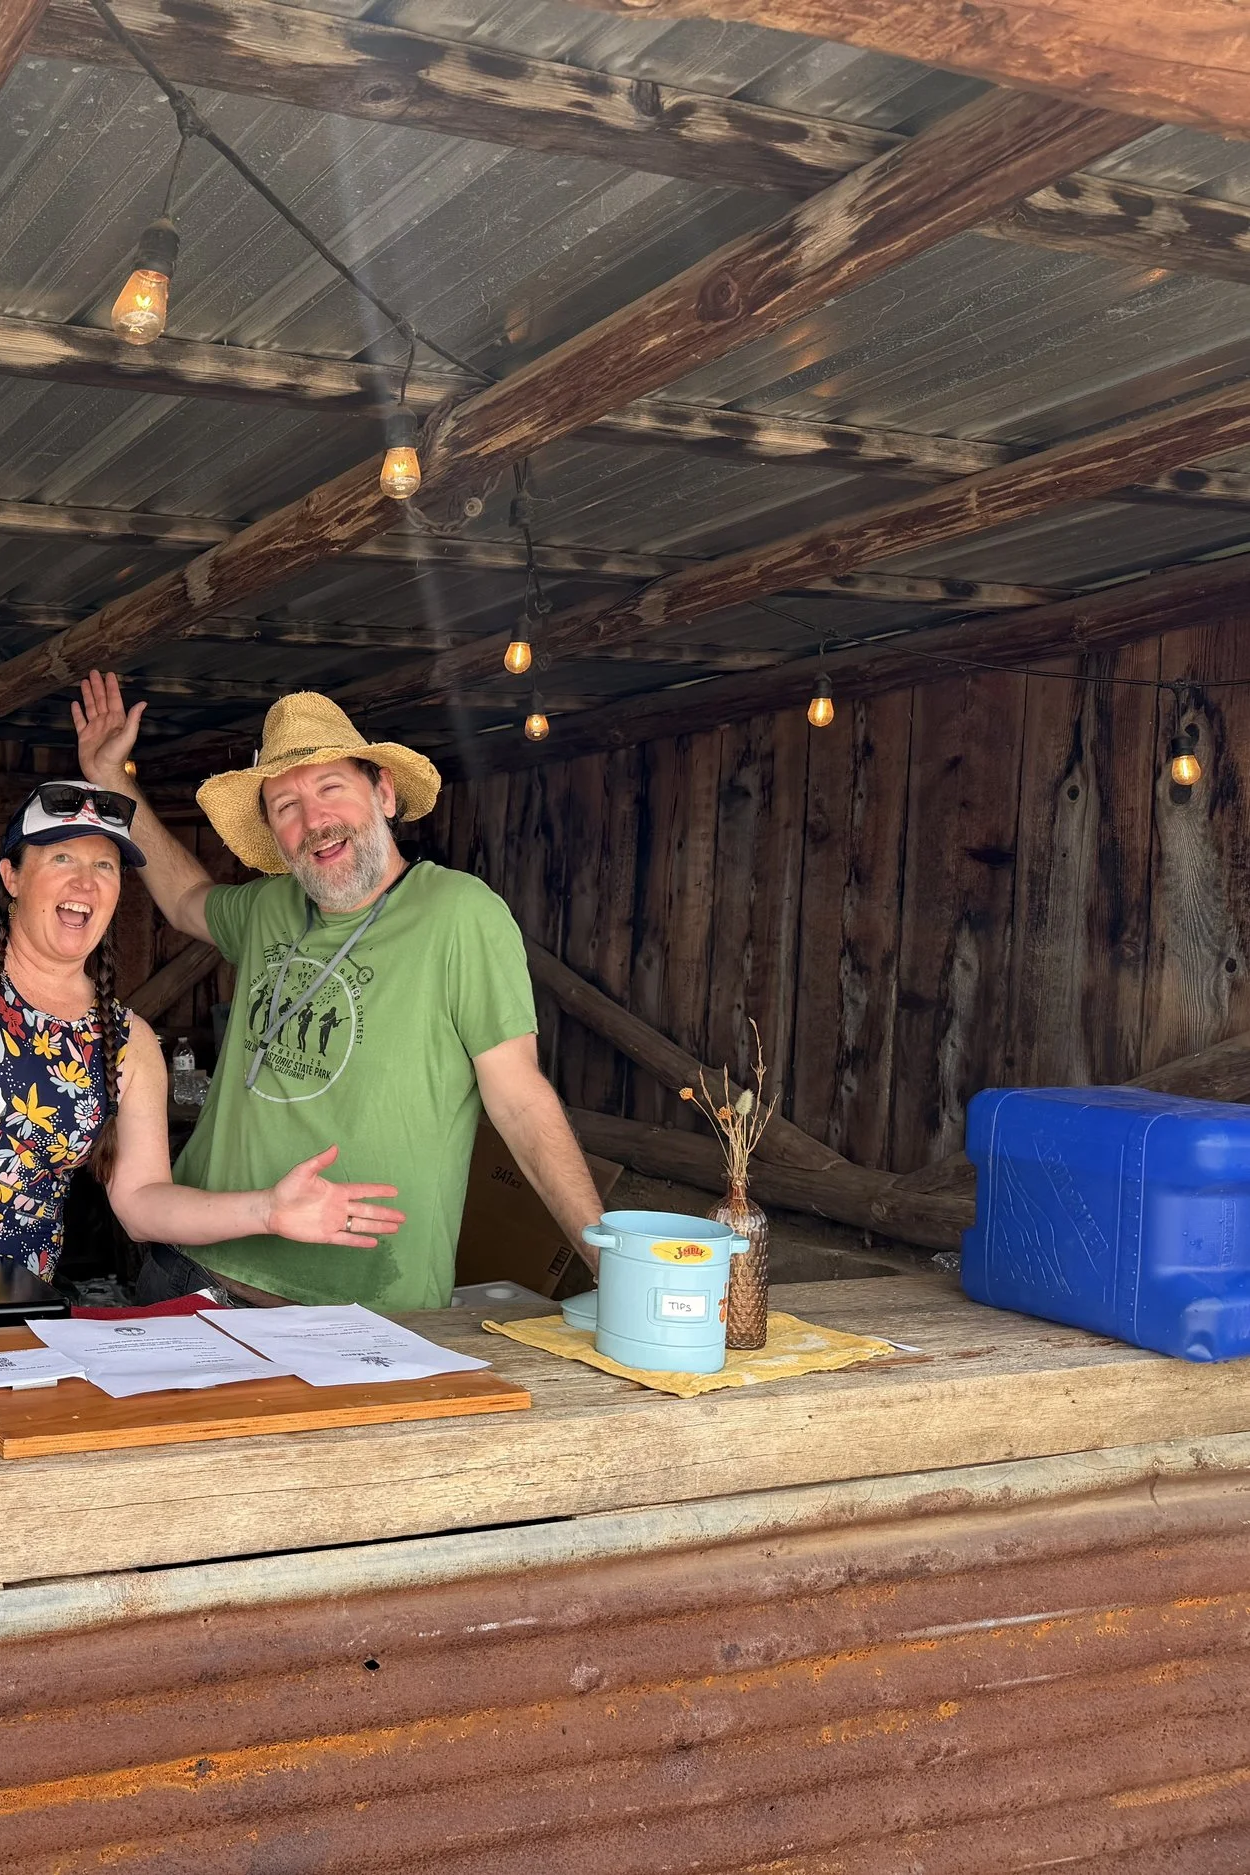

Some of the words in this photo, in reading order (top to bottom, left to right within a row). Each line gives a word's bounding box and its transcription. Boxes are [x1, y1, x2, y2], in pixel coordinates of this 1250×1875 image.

[355, 1004, 364, 1045] CONTEST
[274, 1064, 306, 1081] CALIFORNIA
[293, 1061, 312, 1076] STATE
[313, 1067, 332, 1081] PARK
